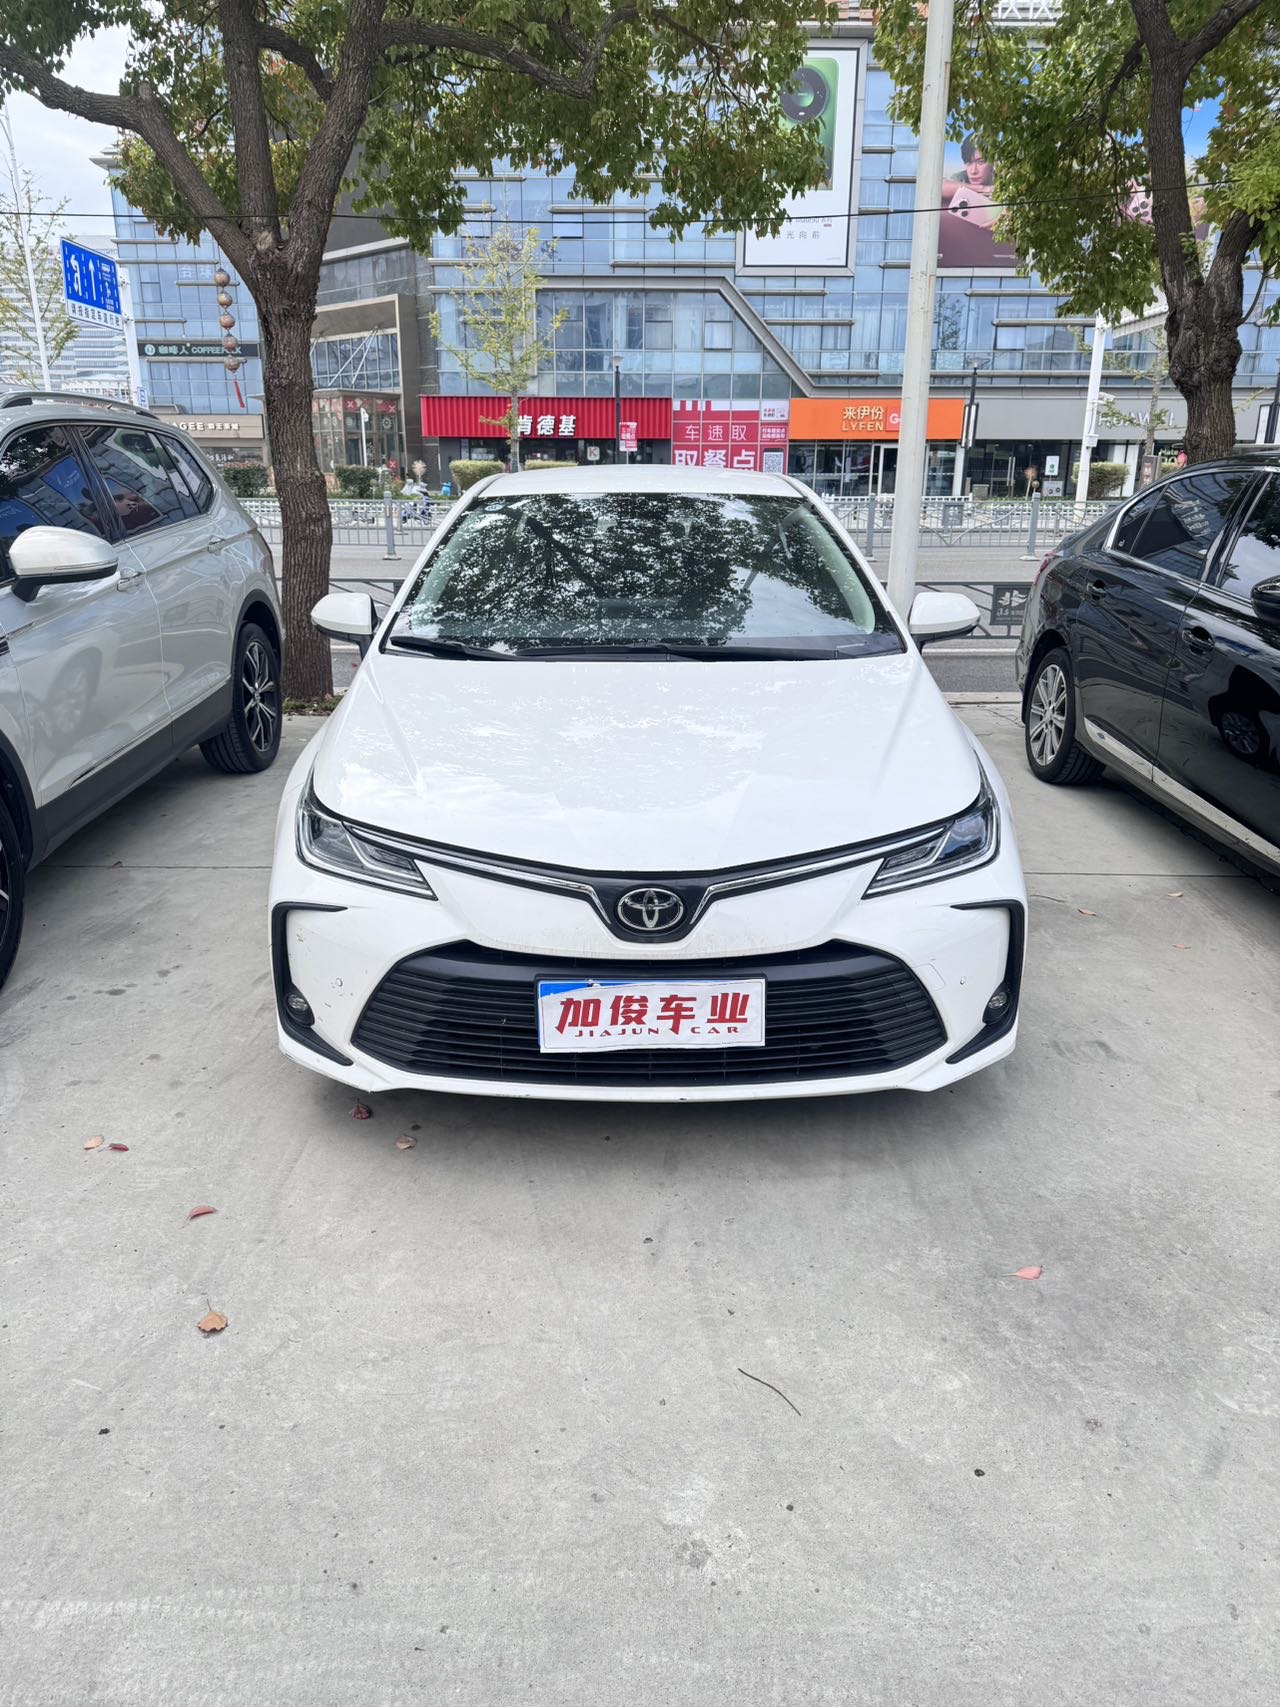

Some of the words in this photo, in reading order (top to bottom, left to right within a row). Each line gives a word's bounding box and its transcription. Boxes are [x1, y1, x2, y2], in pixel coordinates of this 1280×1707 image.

[776, 230, 820, 240] 光向前
[191, 346, 242, 354] COFFEEFK
[842, 405, 885, 420] 来伊份
[517, 415, 577, 437] 肯德基
[684, 424, 747, 441] 车速取
[842, 421, 884, 431] LYFEN
[555, 992, 750, 1035] 加俊车业
[574, 1027, 660, 1038] JIAJUN
[690, 1026, 739, 1035] CAR
